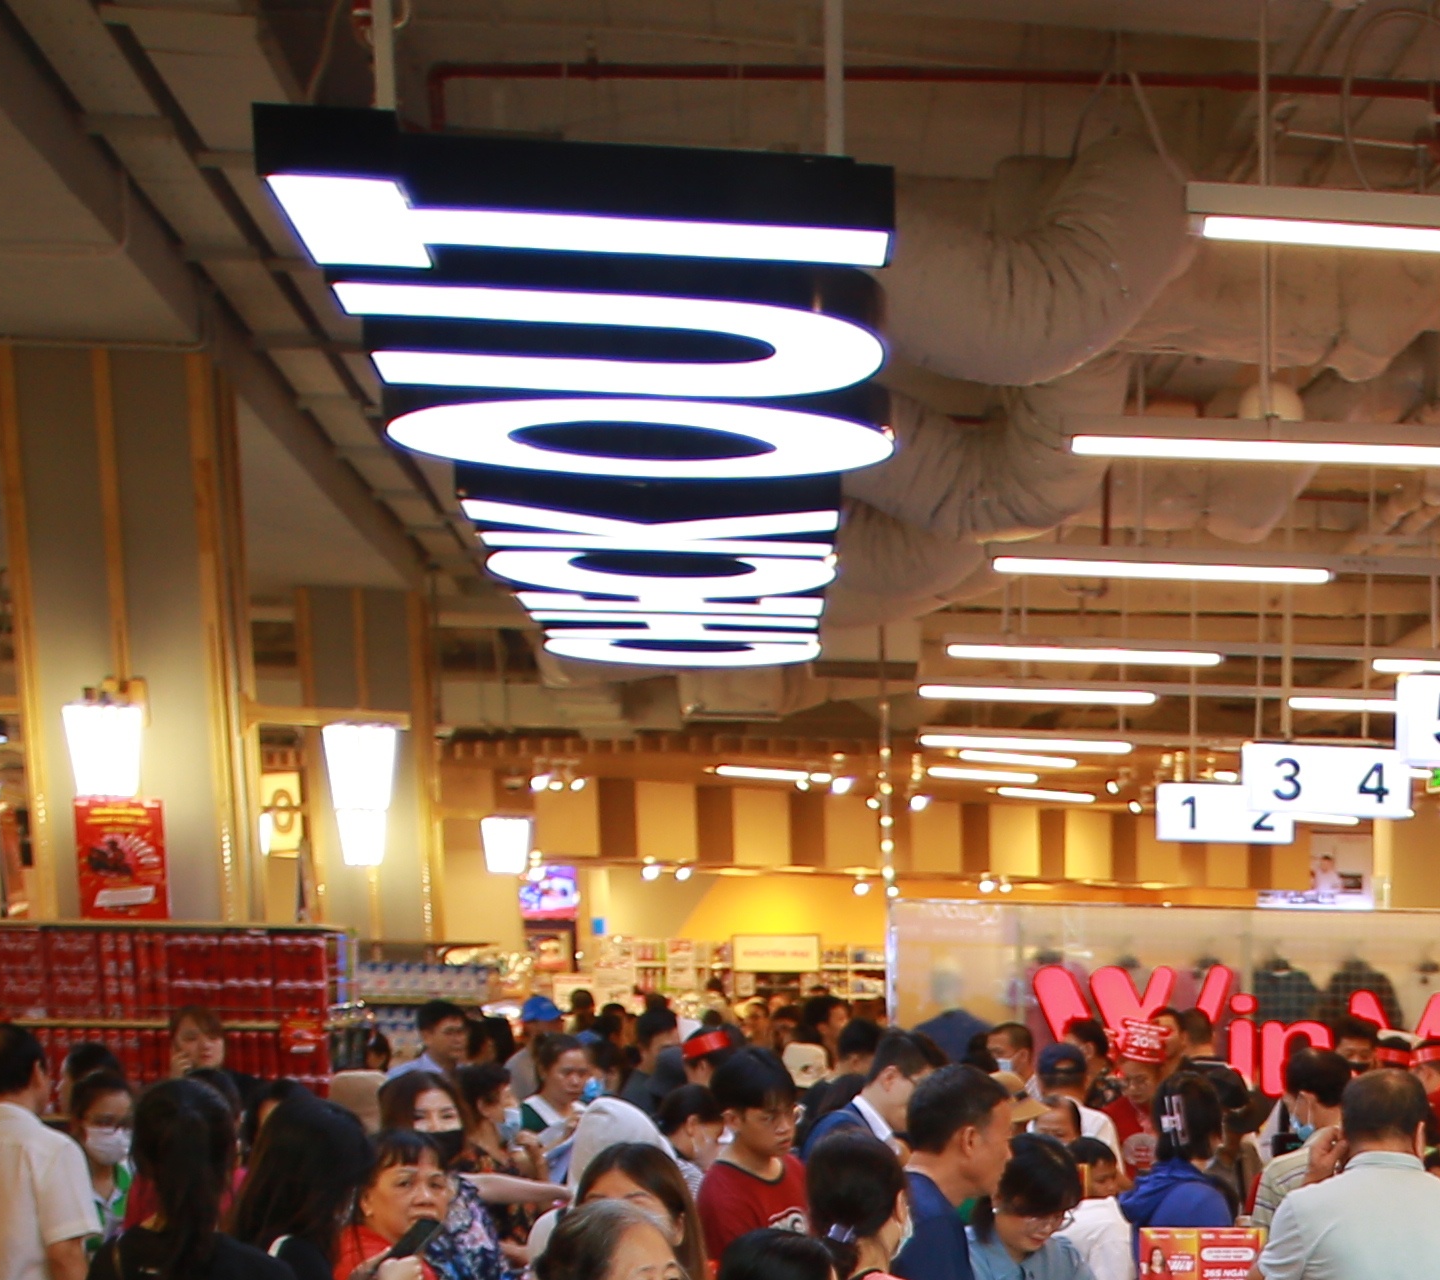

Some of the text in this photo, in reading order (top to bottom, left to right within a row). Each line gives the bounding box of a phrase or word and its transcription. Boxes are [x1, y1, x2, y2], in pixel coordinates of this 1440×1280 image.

[1271, 757, 1391, 804] 3 4
[1180, 796, 1197, 830] 1
